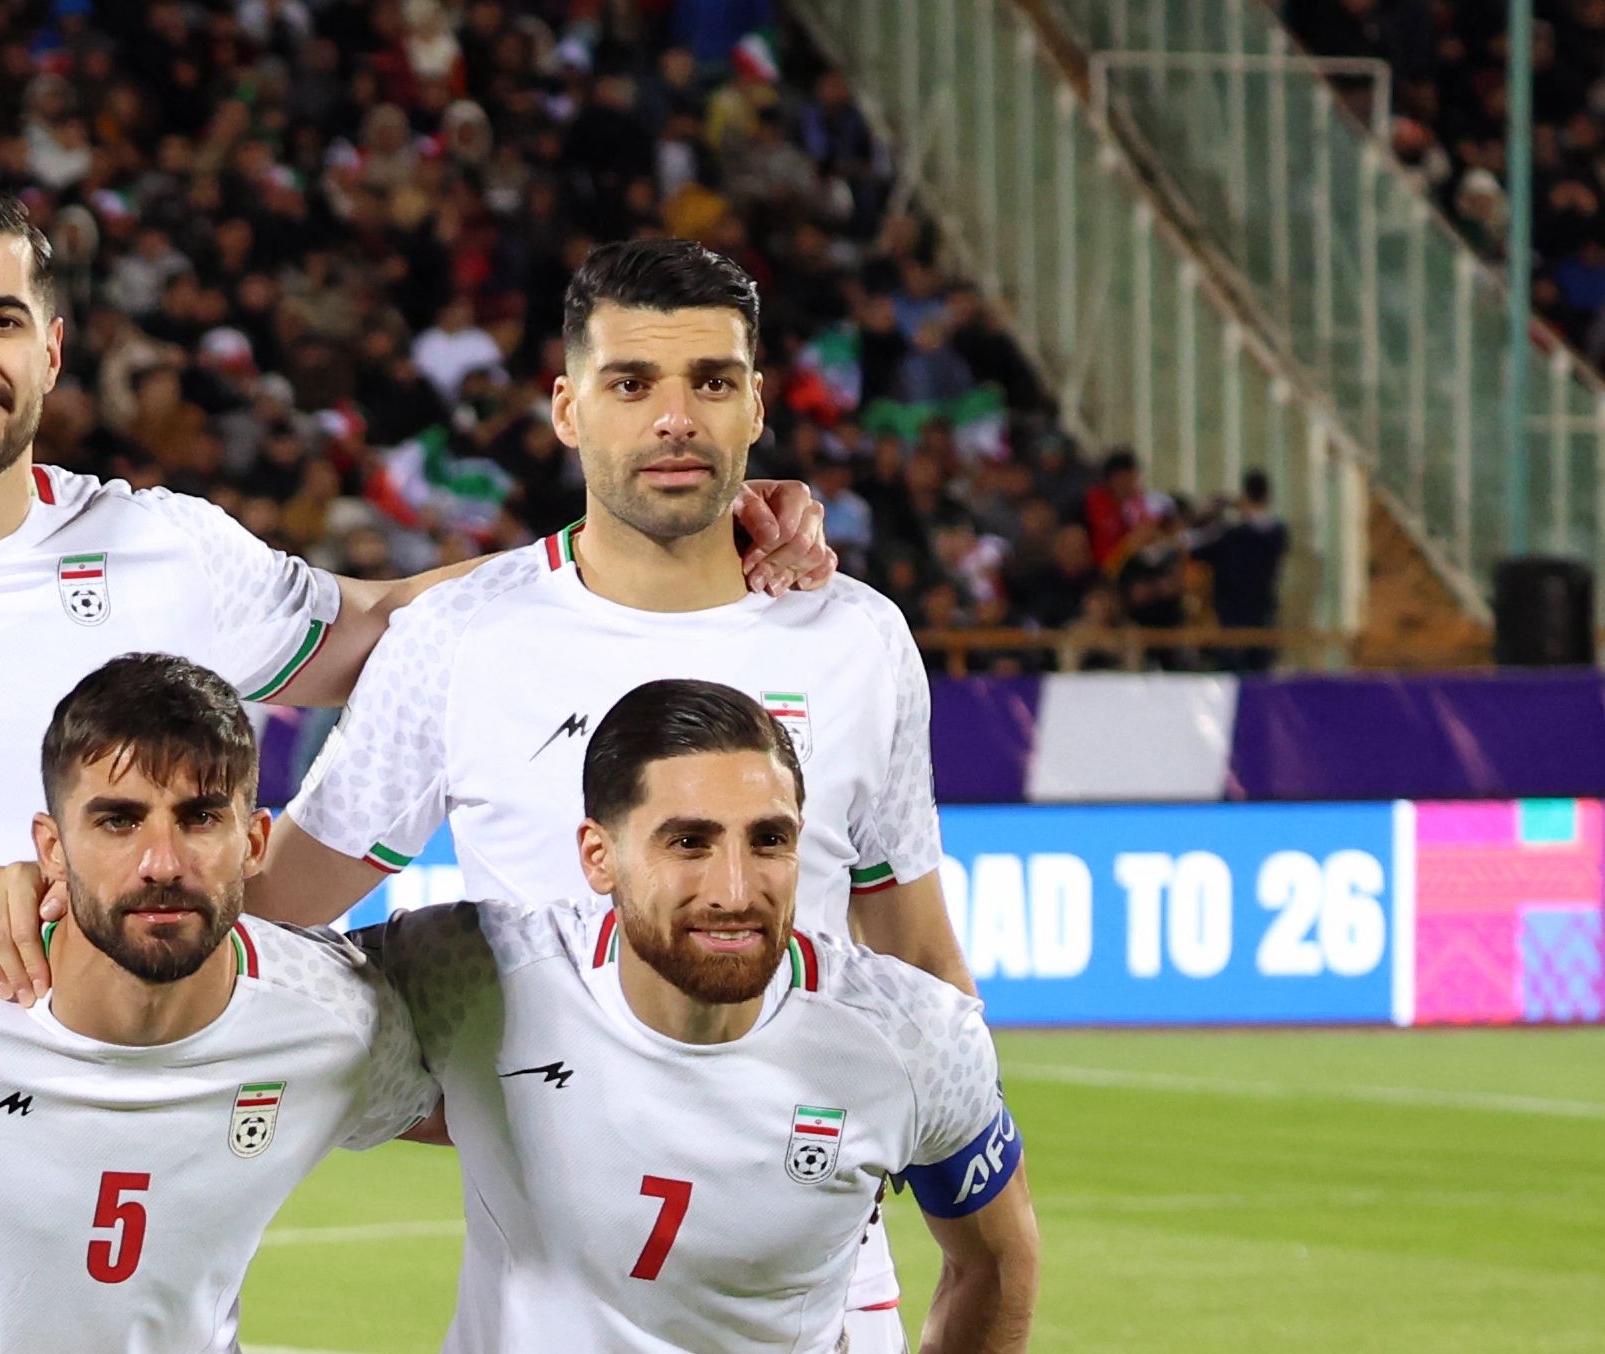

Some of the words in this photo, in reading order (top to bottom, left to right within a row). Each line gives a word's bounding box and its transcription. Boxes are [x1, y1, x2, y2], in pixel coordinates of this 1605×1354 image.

[1113, 850, 1234, 979] TO
[1254, 848, 1387, 978] 26
[952, 1105, 1015, 1205] AFC
[87, 1171, 151, 1284] 5
[630, 1175, 694, 1281] 7
